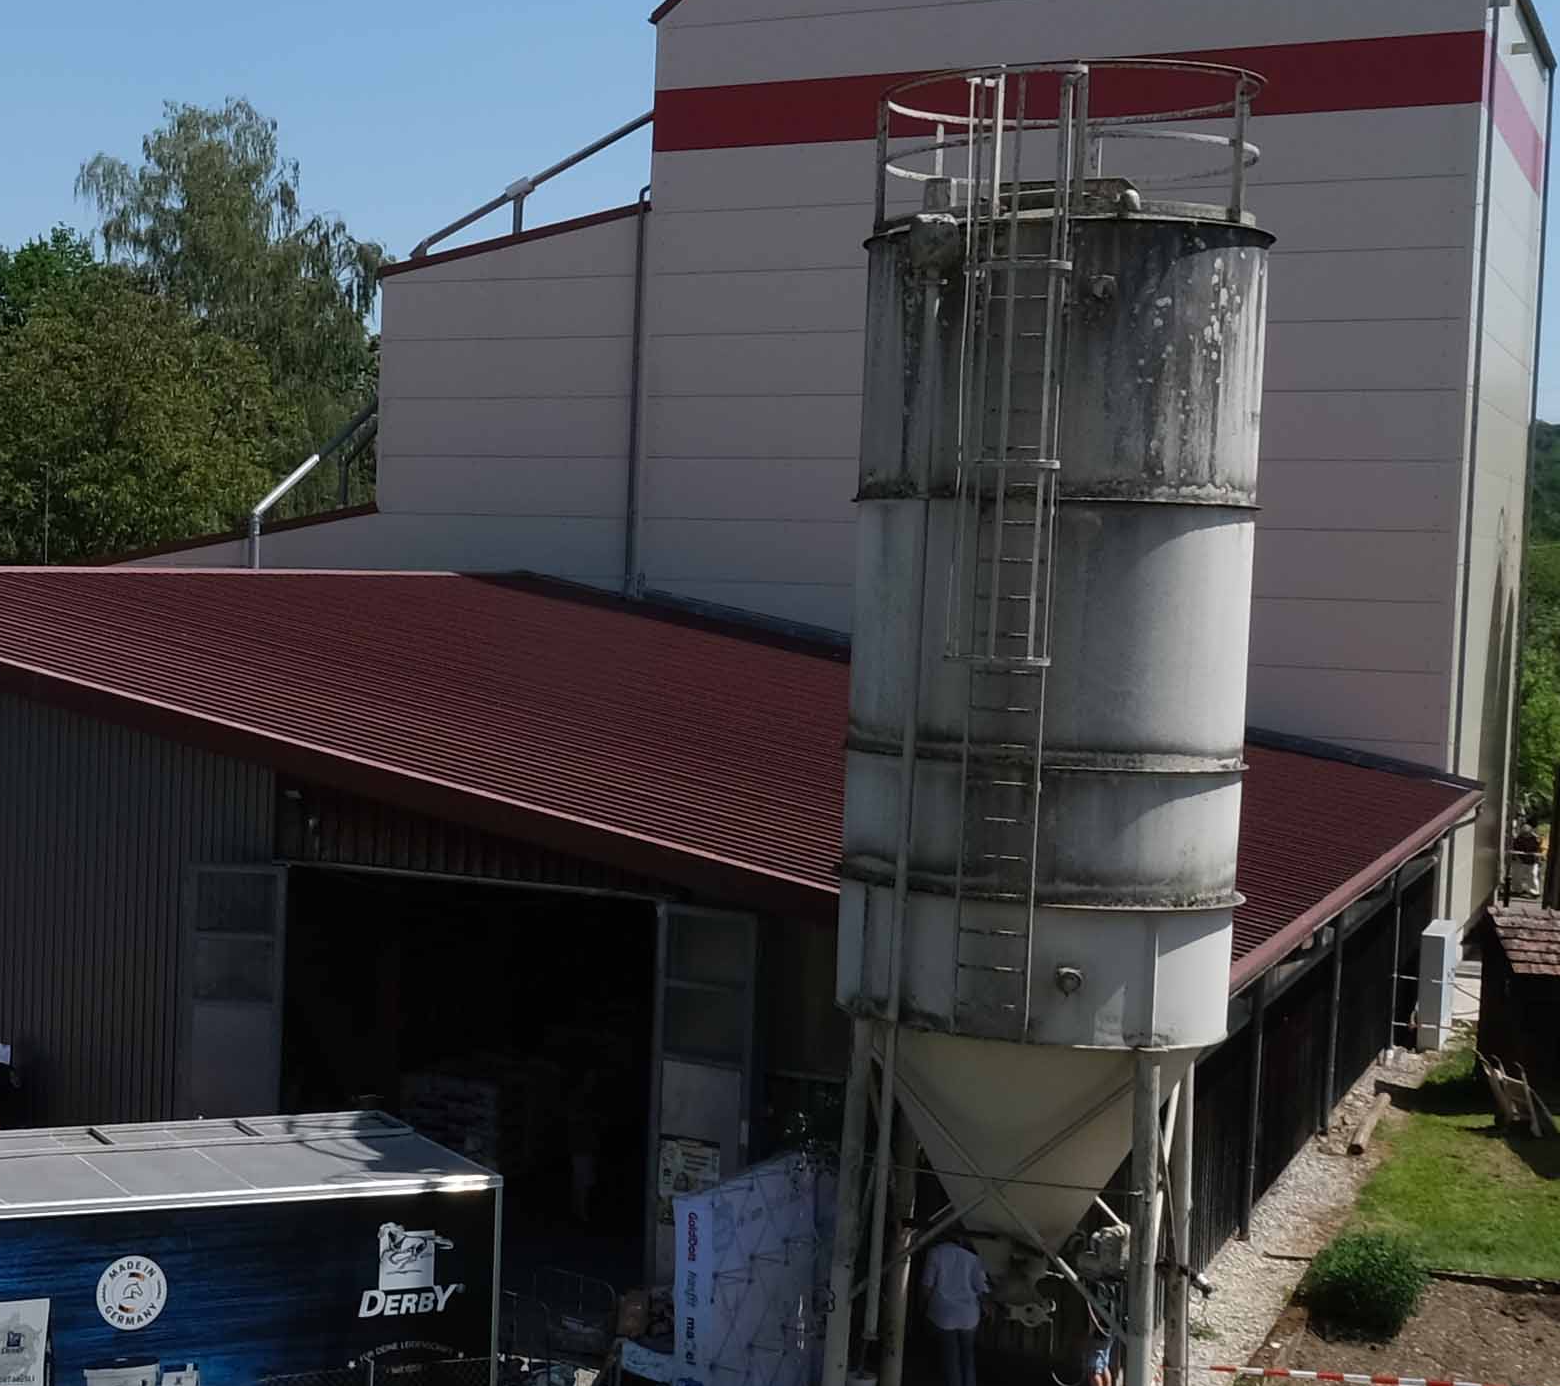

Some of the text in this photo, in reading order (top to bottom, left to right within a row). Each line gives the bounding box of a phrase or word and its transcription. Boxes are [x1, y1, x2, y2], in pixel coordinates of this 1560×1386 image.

[108, 1260, 158, 1280] MADE IN
[357, 1283, 458, 1318] DERBY
[104, 1301, 158, 1326] GERMANY
